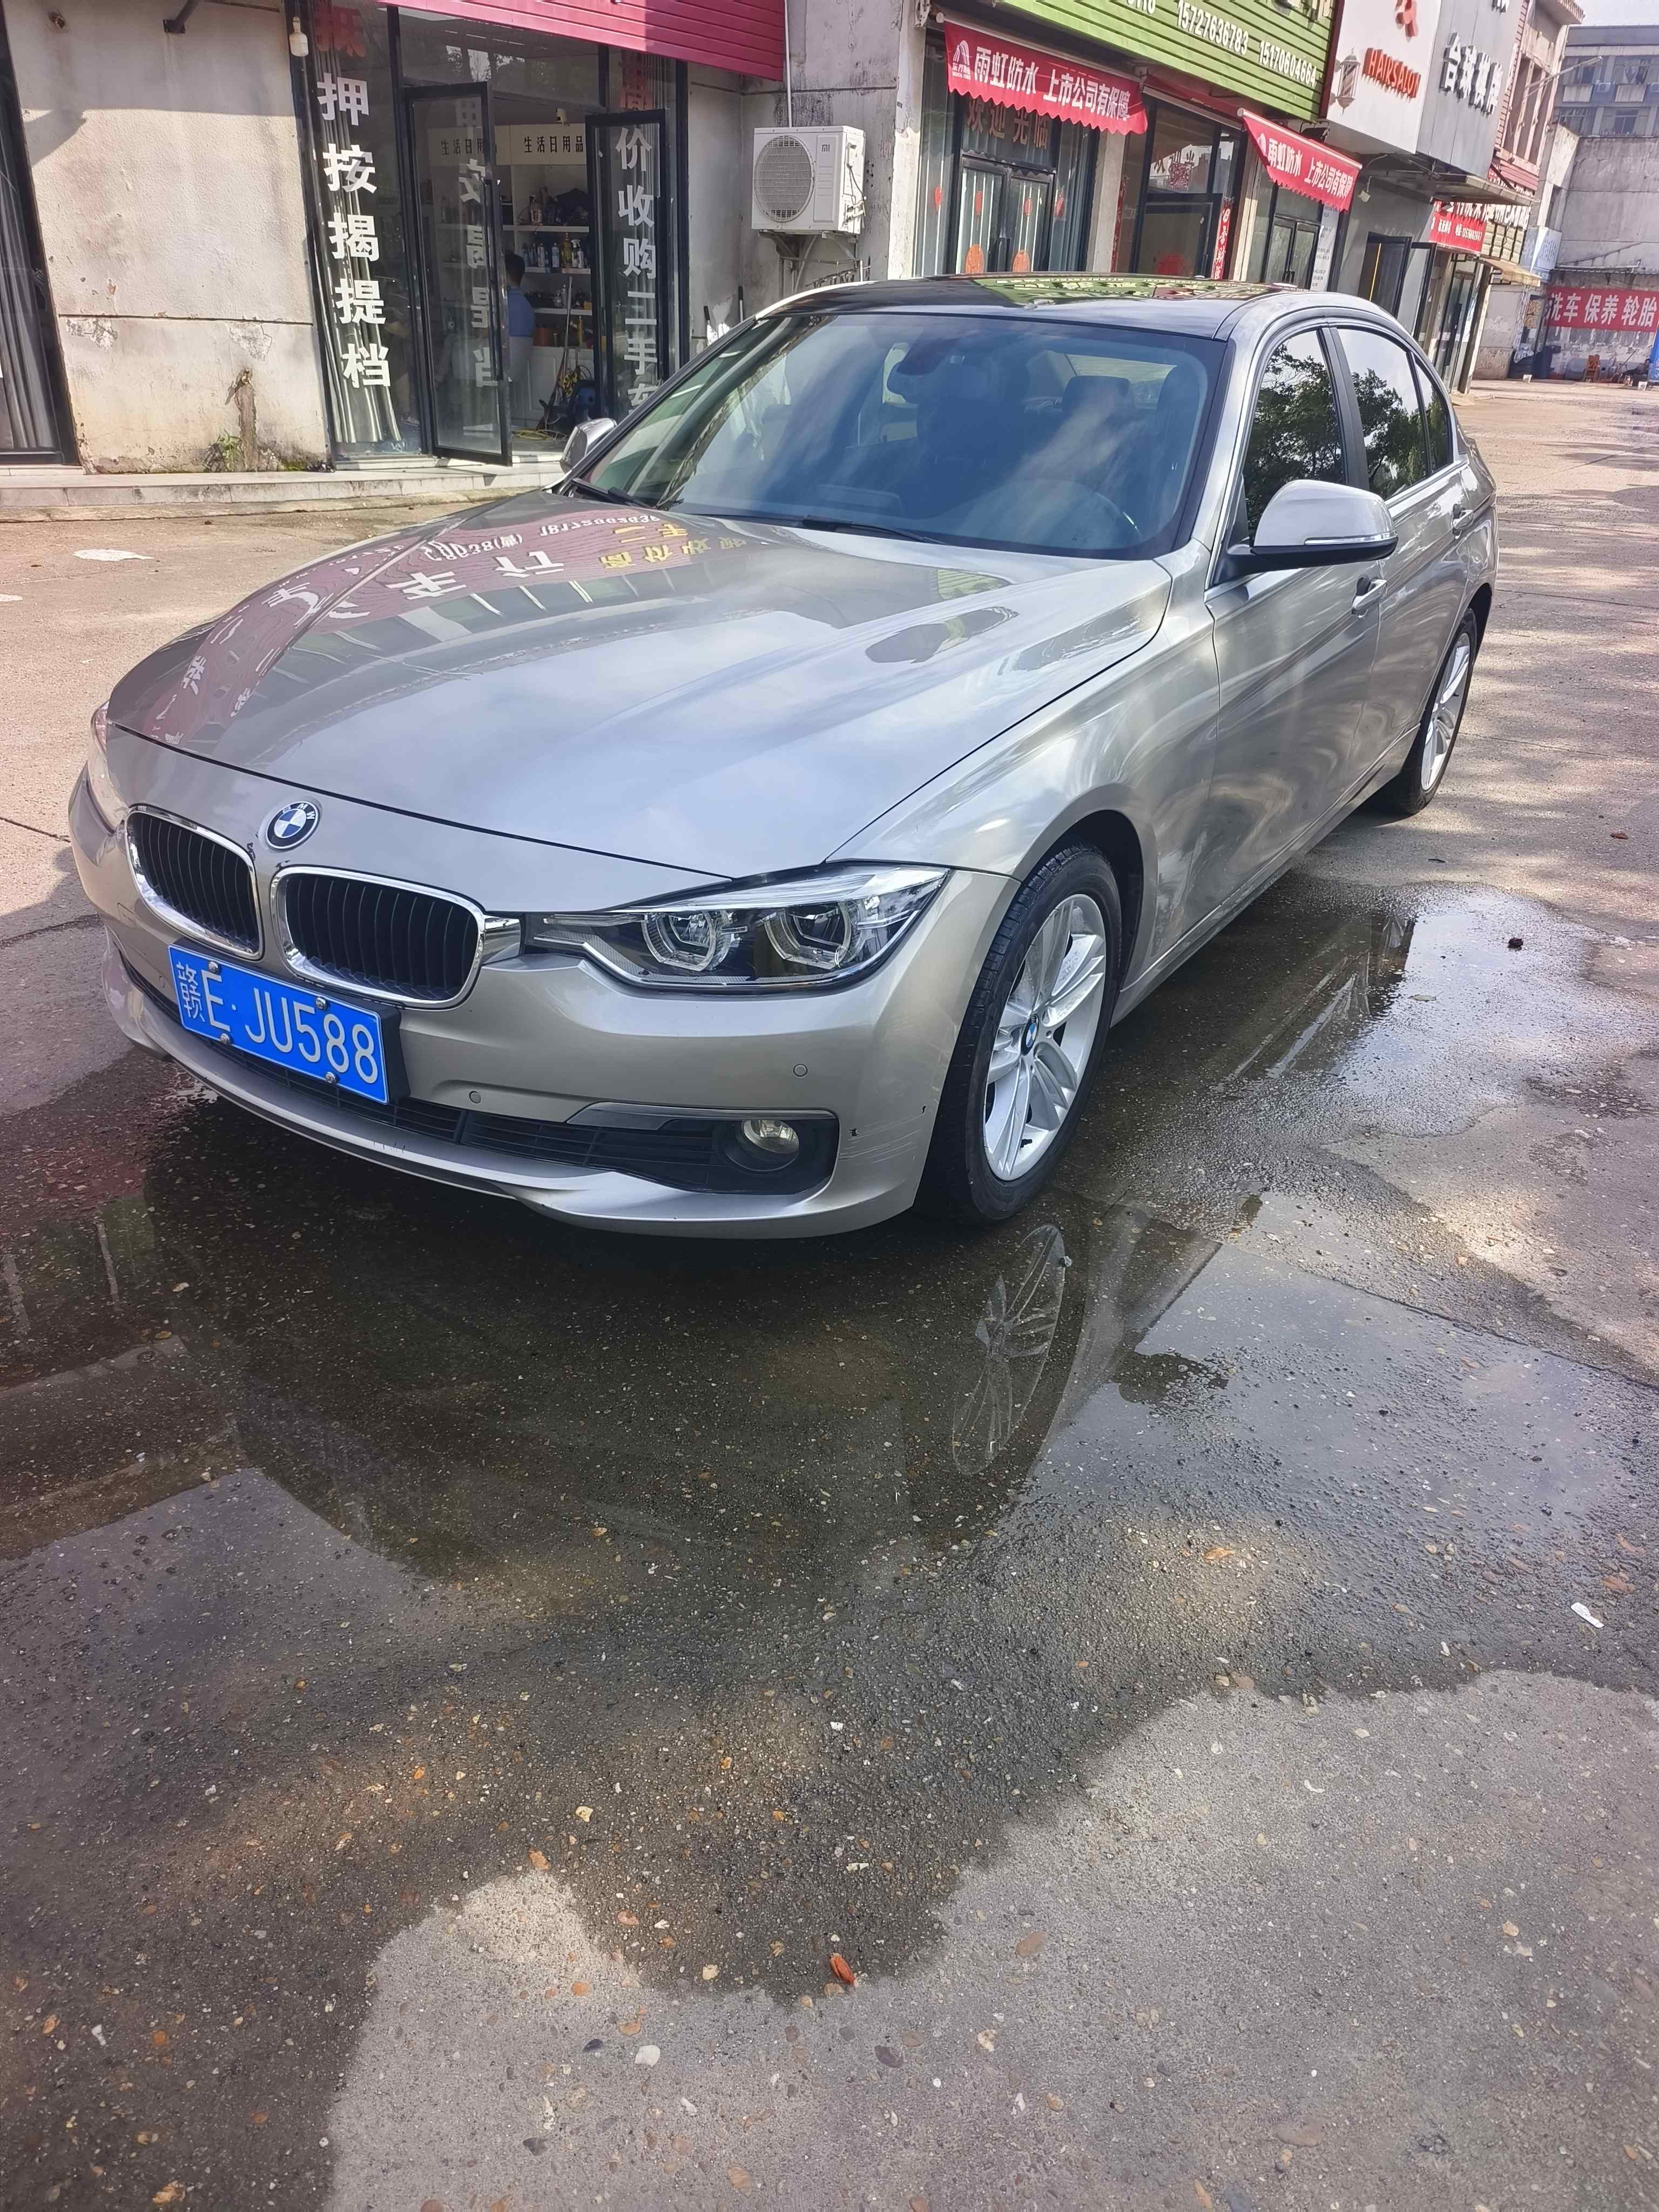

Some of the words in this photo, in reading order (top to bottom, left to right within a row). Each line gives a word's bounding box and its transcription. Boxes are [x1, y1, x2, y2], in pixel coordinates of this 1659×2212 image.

[1177, 0, 1249, 55] 15727636783
[1259, 41, 1317, 87] 15170604664
[974, 46, 1040, 95] 雨虹防水
[1043, 69, 1130, 121] 上市公司有保障
[524, 136, 583, 153] 生活日用品
[1268, 138, 1303, 177] 雨虹防水
[1547, 292, 1581, 322] 洗车
[1584, 293, 1619, 325] 保养
[1621, 295, 1657, 327] 轮胎
[282, 802, 316, 820] BMW
